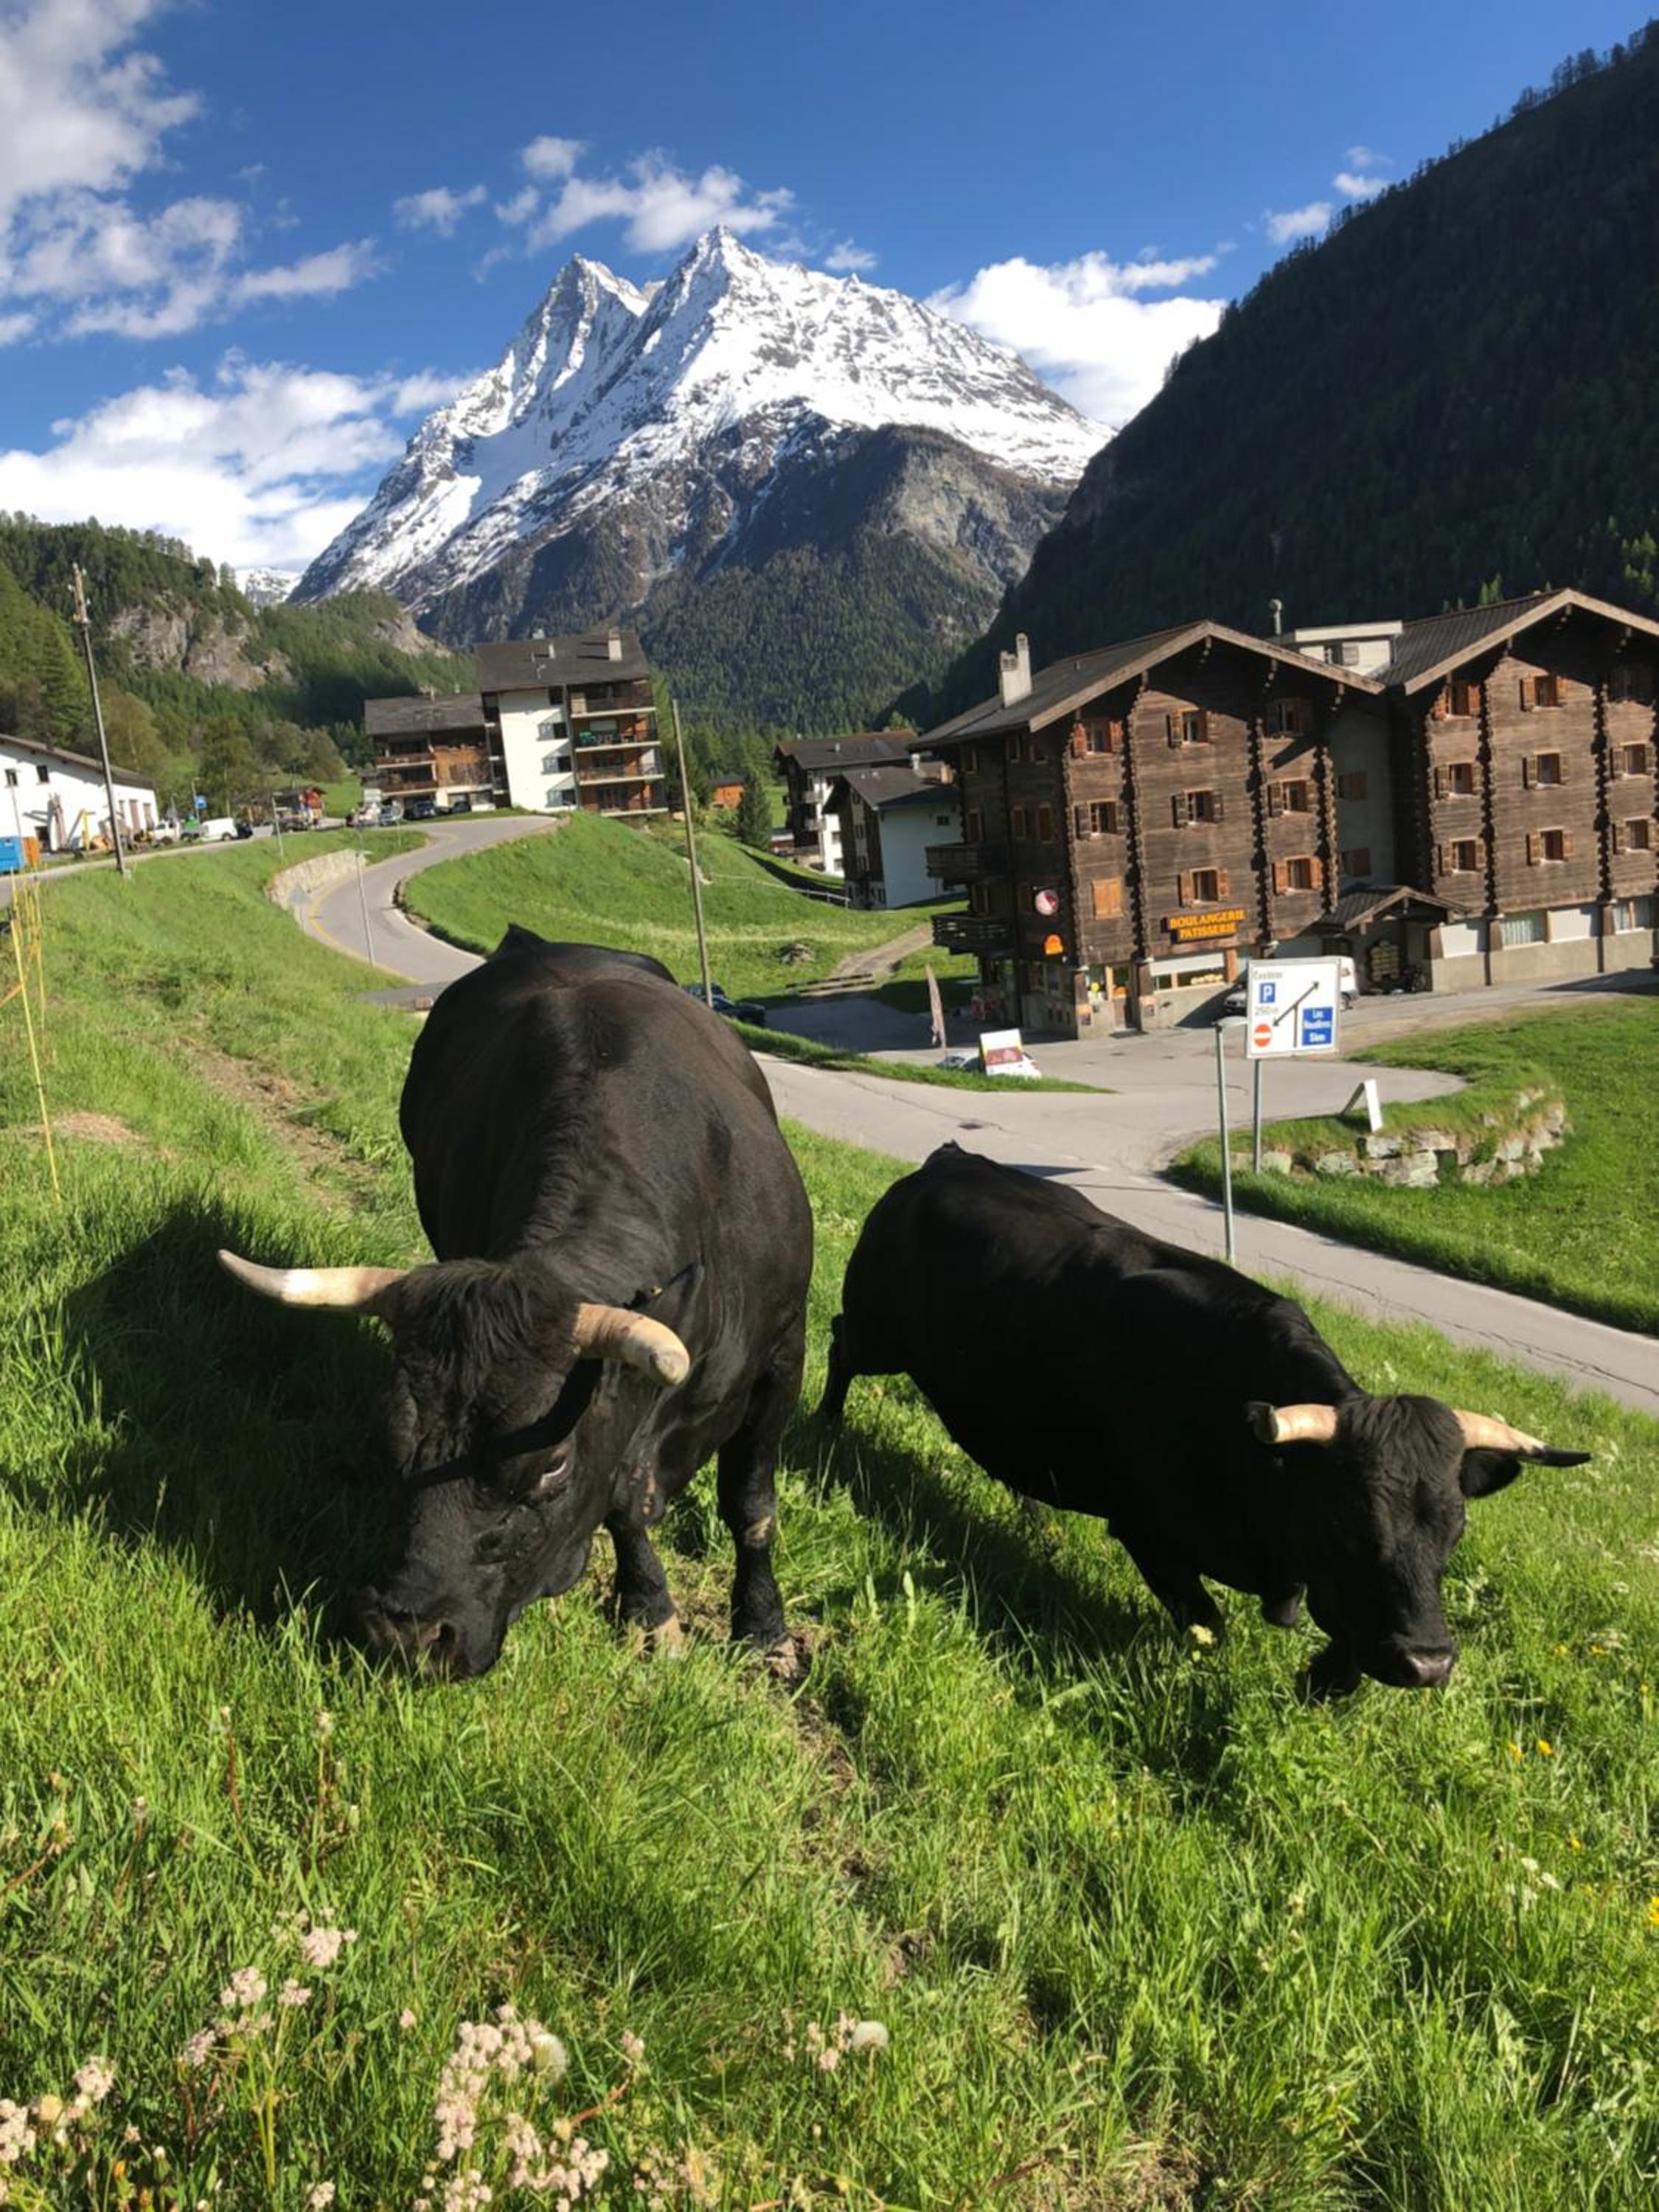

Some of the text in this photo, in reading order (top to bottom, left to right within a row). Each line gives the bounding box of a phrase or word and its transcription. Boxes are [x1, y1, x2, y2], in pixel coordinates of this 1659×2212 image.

[1169, 909, 1245, 929] BOULANGERIE
[1180, 922, 1237, 940] PATISSERIE
[1263, 985, 1273, 1001] P
